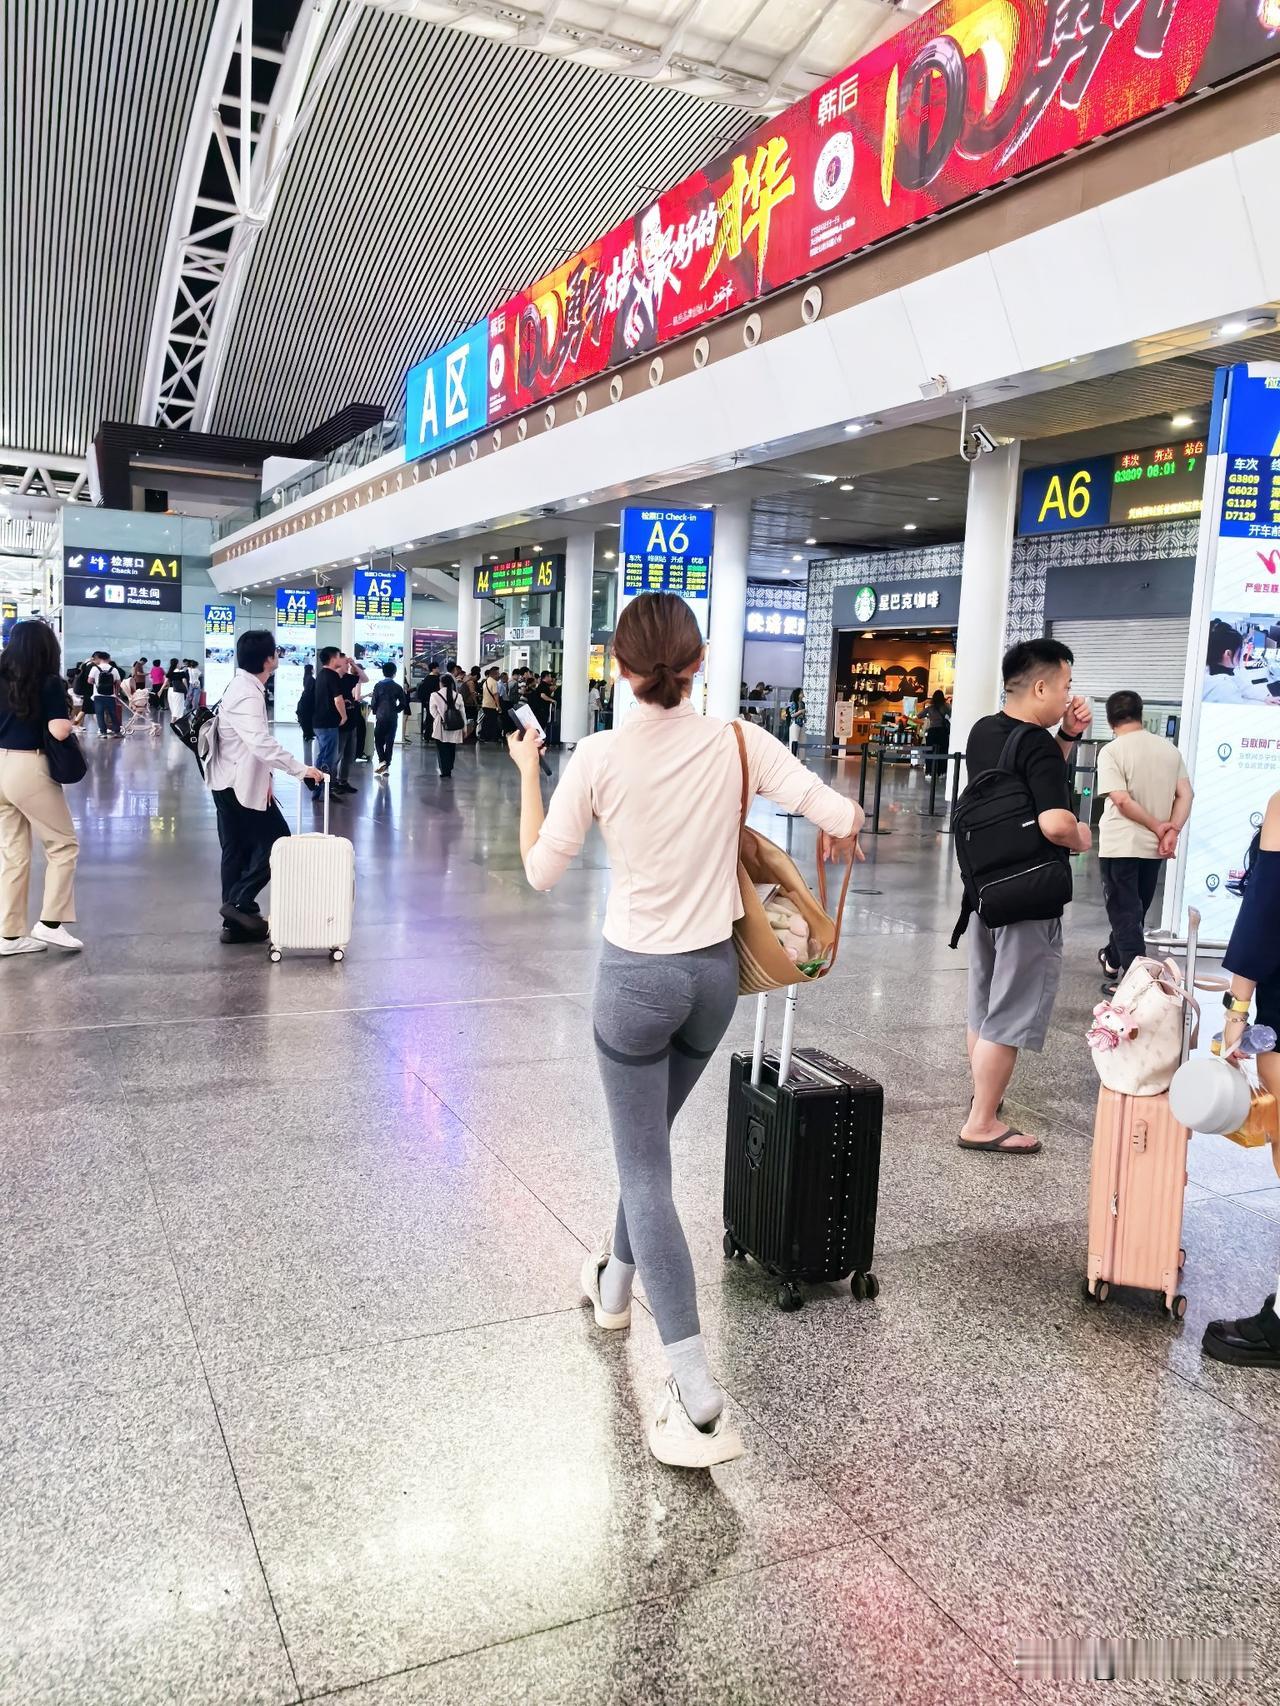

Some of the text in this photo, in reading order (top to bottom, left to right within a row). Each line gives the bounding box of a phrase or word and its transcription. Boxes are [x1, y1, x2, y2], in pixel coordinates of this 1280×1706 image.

[817, 73, 859, 127] 韩后
[1122, 441, 1204, 468] 车次 开点 站台
[1147, 462, 1175, 478] 08:01
[1188, 458, 1196, 471] 7
[1233, 457, 1259, 471] 车次
[1229, 474, 1260, 485] G3809
[1038, 470, 1092, 522] A6
[1228, 486, 1258, 496] G6023
[1226, 498, 1257, 509] G1184
[665, 512, 697, 522] Check-in
[1225, 511, 1256, 521] D7129
[646, 520, 689, 554] A6
[110, 555, 145, 568] 检票口
[149, 558, 178, 578] A1
[477, 570, 490, 593] A4
[537, 560, 553, 587] A5
[127, 586, 161, 599] 卫生间
[367, 578, 393, 598] A5
[127, 598, 161, 606] Restrooms
[287, 594, 307, 610] A4
[878, 590, 940, 611] 星巴克咖啡
